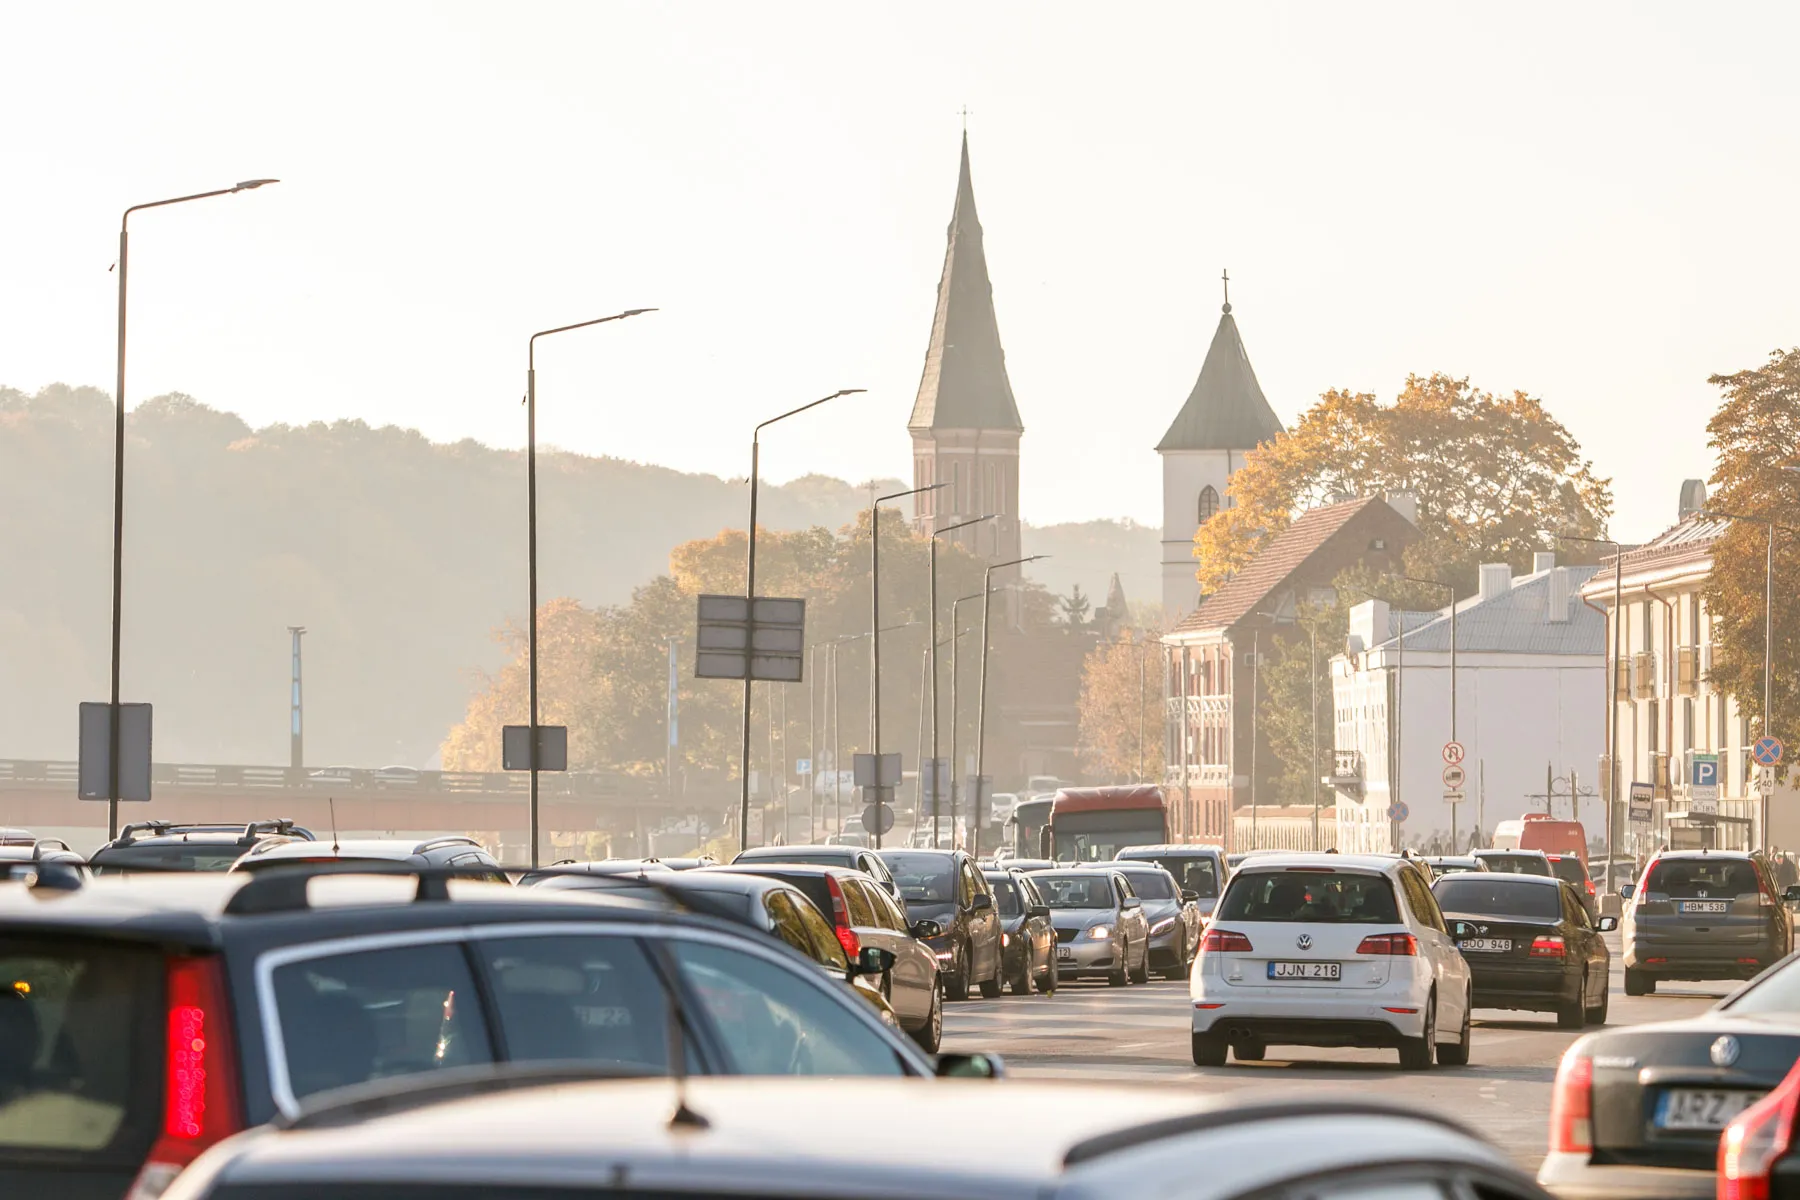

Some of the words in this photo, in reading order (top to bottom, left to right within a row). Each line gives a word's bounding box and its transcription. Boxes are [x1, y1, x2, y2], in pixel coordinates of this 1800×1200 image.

[1698, 762, 1714, 784] P
[1762, 780, 1772, 788] 40
[1684, 903, 1704, 911] HBM
[1708, 903, 1725, 911] 536
[1490, 940, 1510, 950] 948
[1277, 964, 1306, 976] JJN
[1313, 965, 1338, 977] 218
[1671, 1092, 1726, 1124] ARZ
